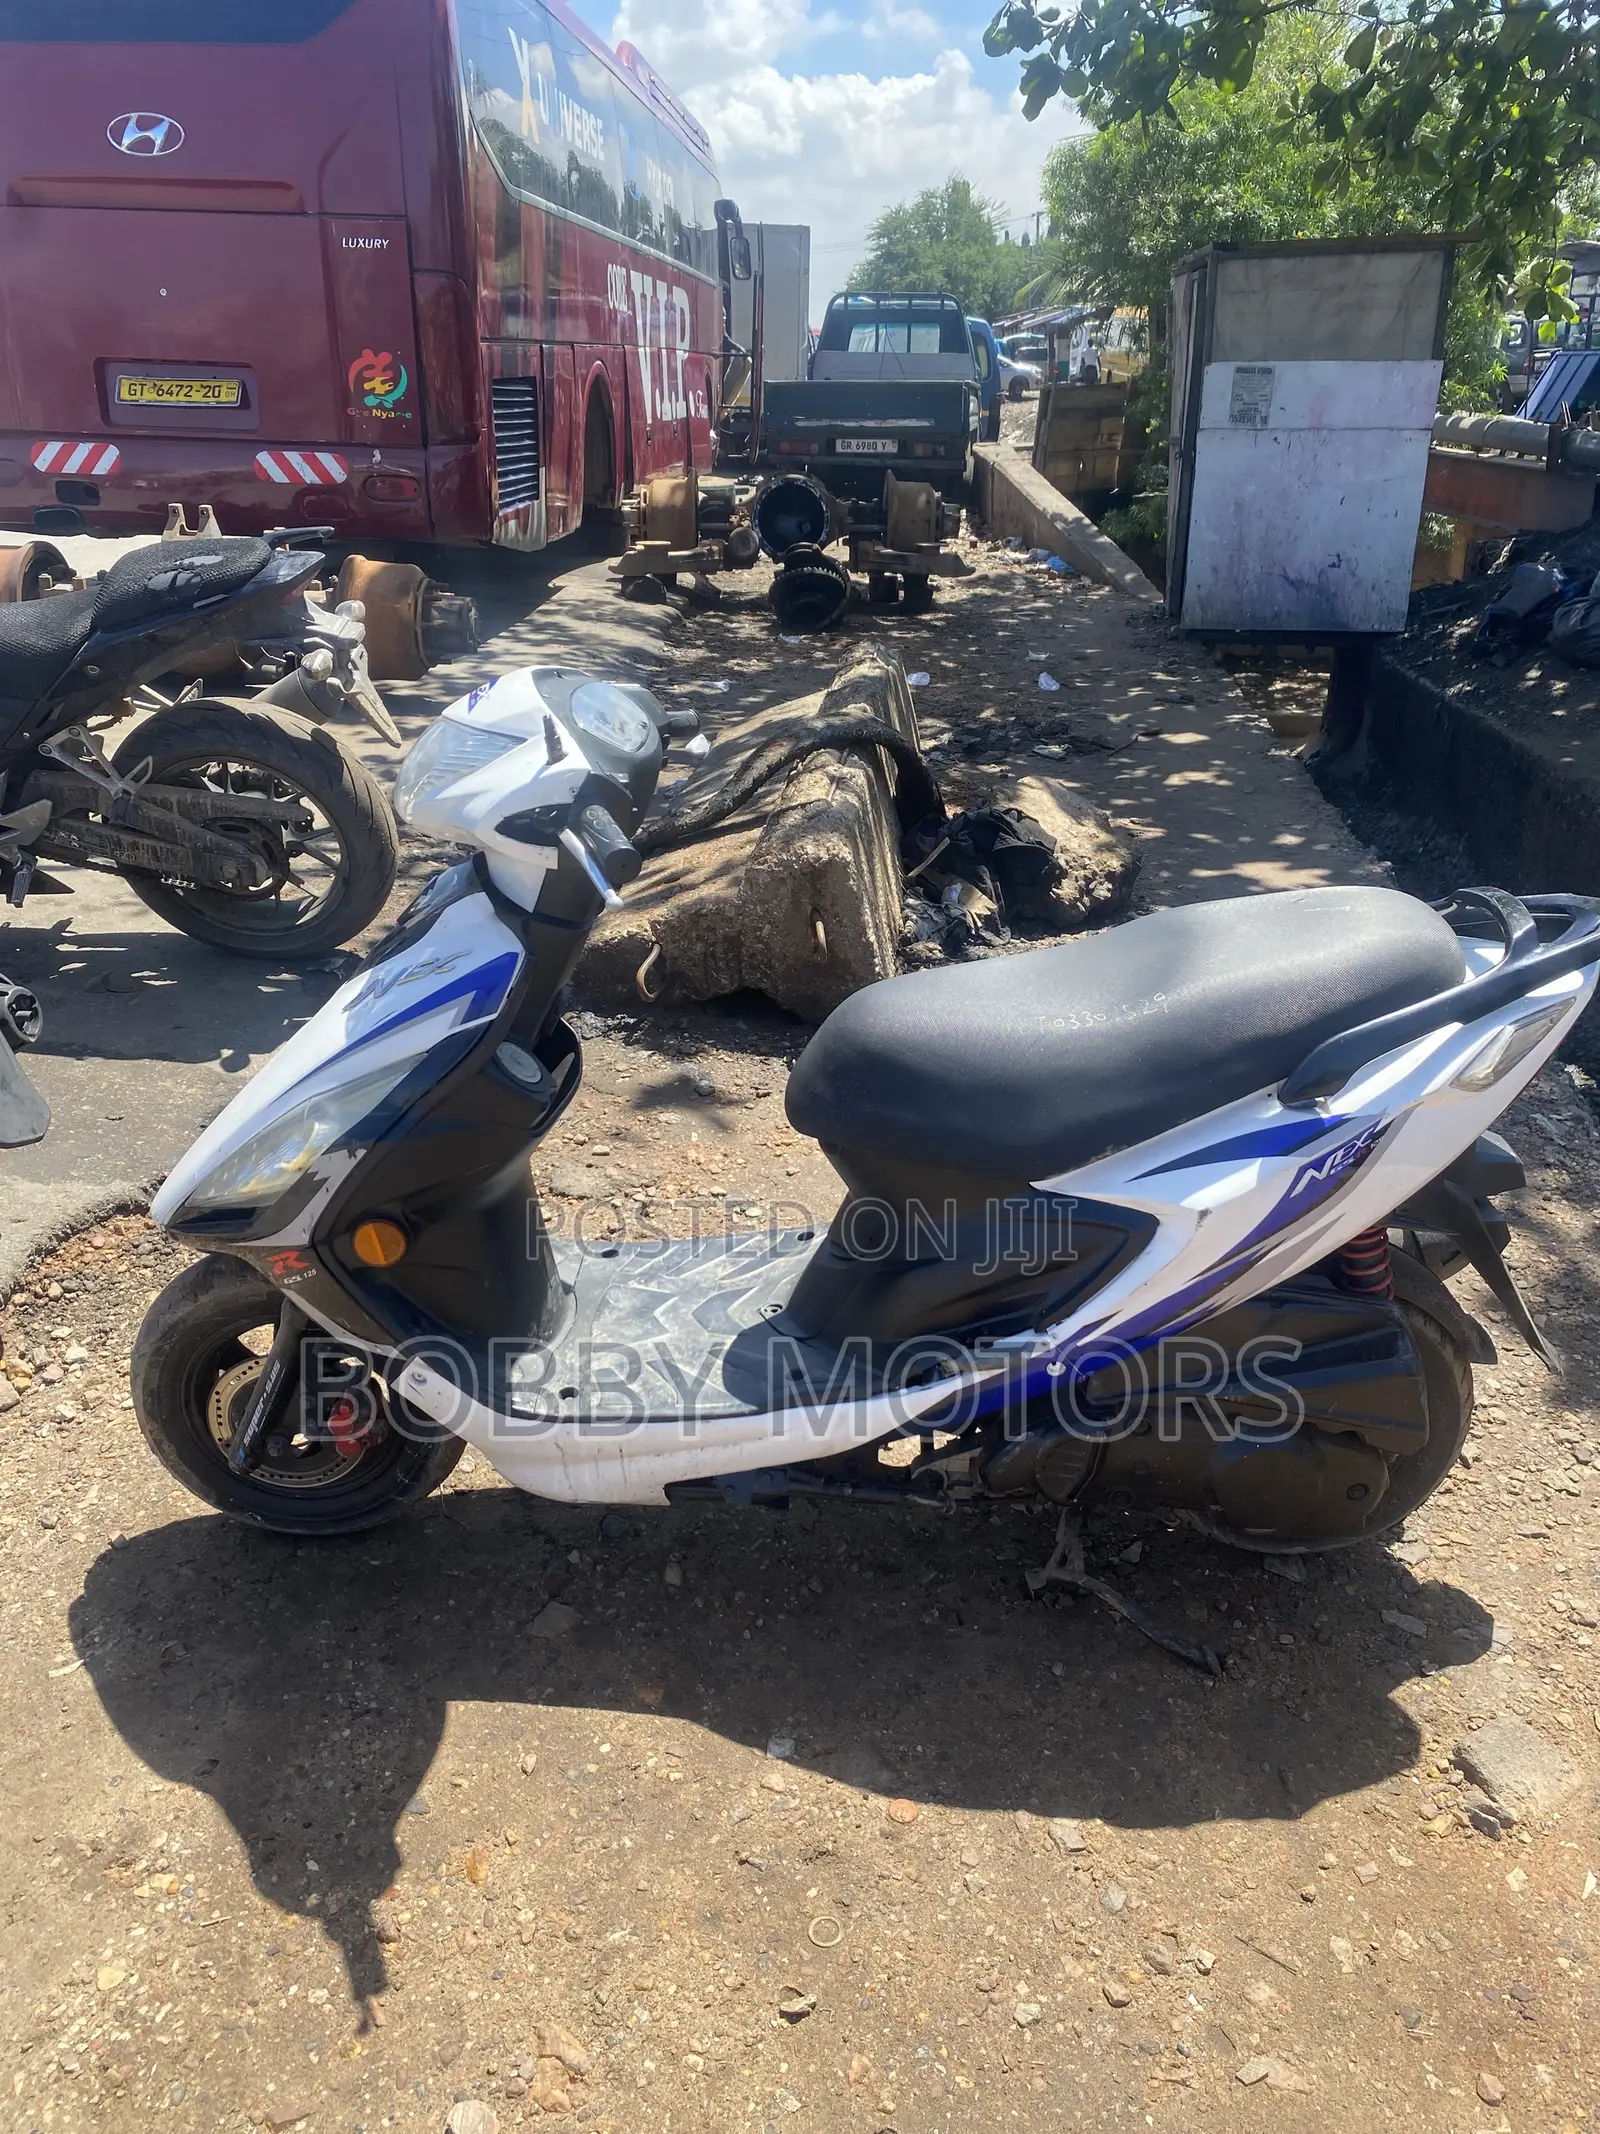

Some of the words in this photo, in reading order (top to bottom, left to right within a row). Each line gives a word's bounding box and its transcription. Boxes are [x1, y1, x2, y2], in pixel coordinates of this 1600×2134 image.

[342, 237, 390, 249] LUXURY
[127, 382, 148, 397] GT
[155, 383, 223, 399] 6472-20
[840, 440, 852, 450] GR
[855, 441, 878, 451] 6980
[881, 441, 888, 451] Y
[1289, 1127, 1375, 1199] NEX
[303, 1268, 317, 1279] 125
